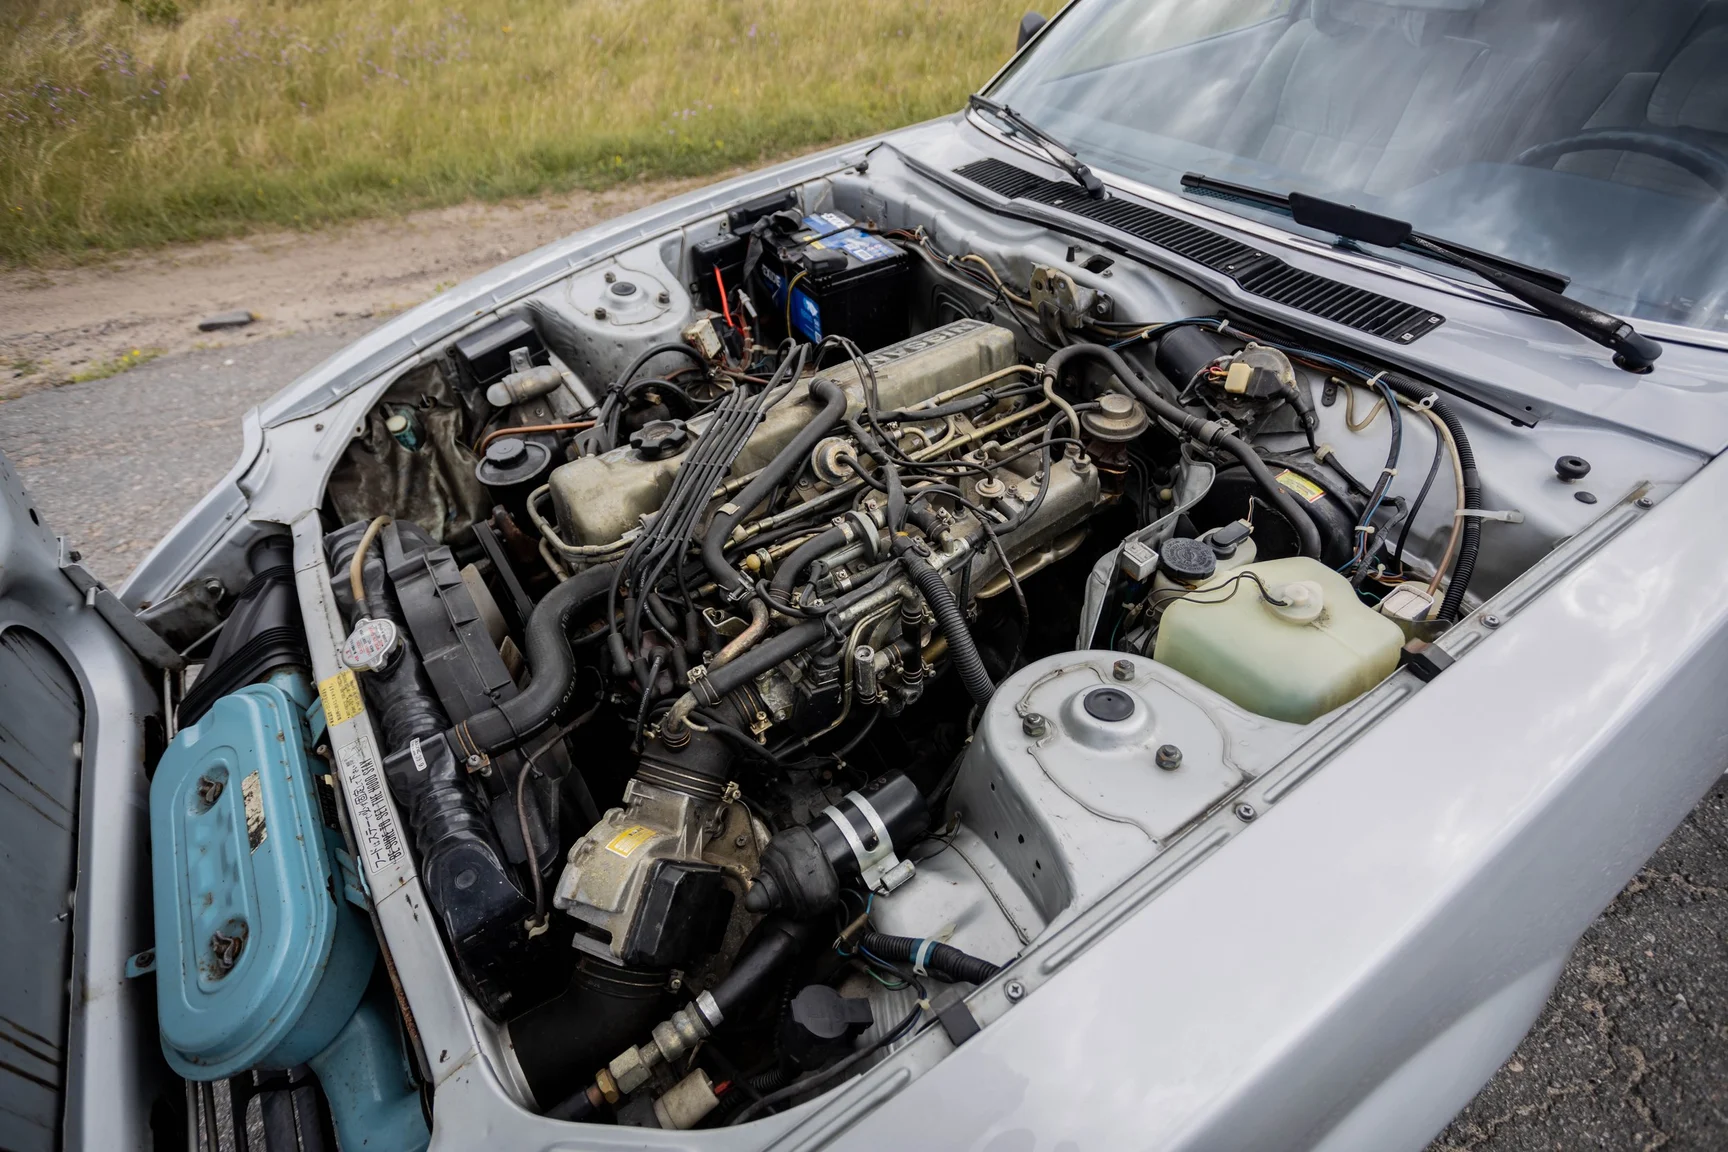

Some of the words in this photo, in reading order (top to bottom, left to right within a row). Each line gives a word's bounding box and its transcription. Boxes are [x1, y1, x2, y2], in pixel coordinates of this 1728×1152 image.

[762, 263, 782, 288] EXIDE
[866, 323, 978, 366] NISSAN
[360, 757, 375, 775] STAY
[365, 774, 380, 794] HOOD
[369, 791, 384, 807] THE
[374, 805, 389, 820] SET
[379, 819, 392, 831] TO
[382, 829, 398, 850] SURE
[388, 850, 402, 861] BE
